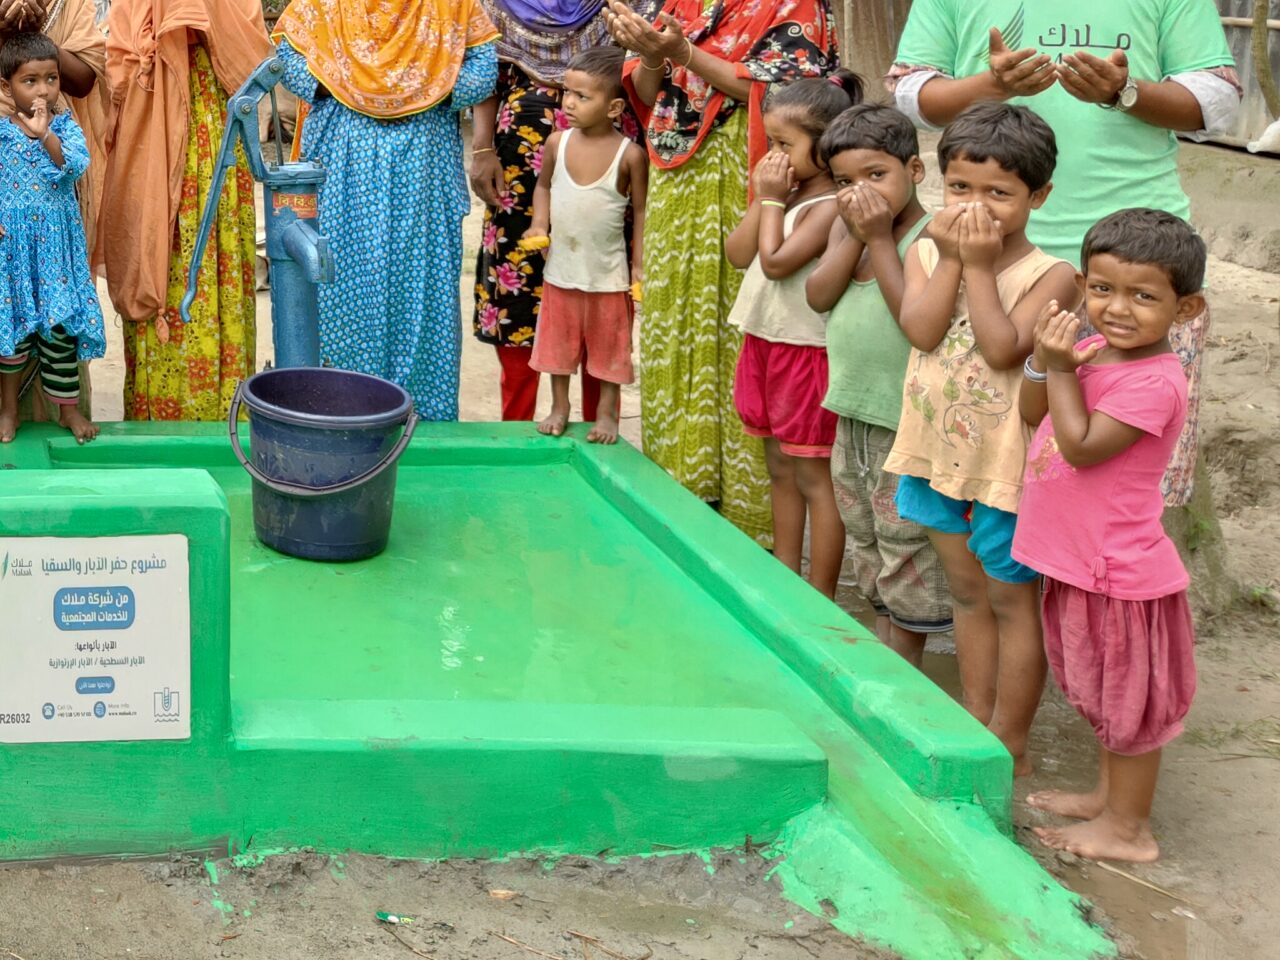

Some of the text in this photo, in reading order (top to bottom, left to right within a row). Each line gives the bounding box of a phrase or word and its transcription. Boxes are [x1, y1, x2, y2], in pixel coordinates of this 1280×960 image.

[1038, 23, 1131, 51] ملاك
[11, 558, 33, 568] ملاك
[41, 553, 168, 576] مشروع حفر الآبار والسقيا
[61, 590, 129, 608] من شركة ملاك
[61, 610, 128, 625] للخدمات المجتمعية
